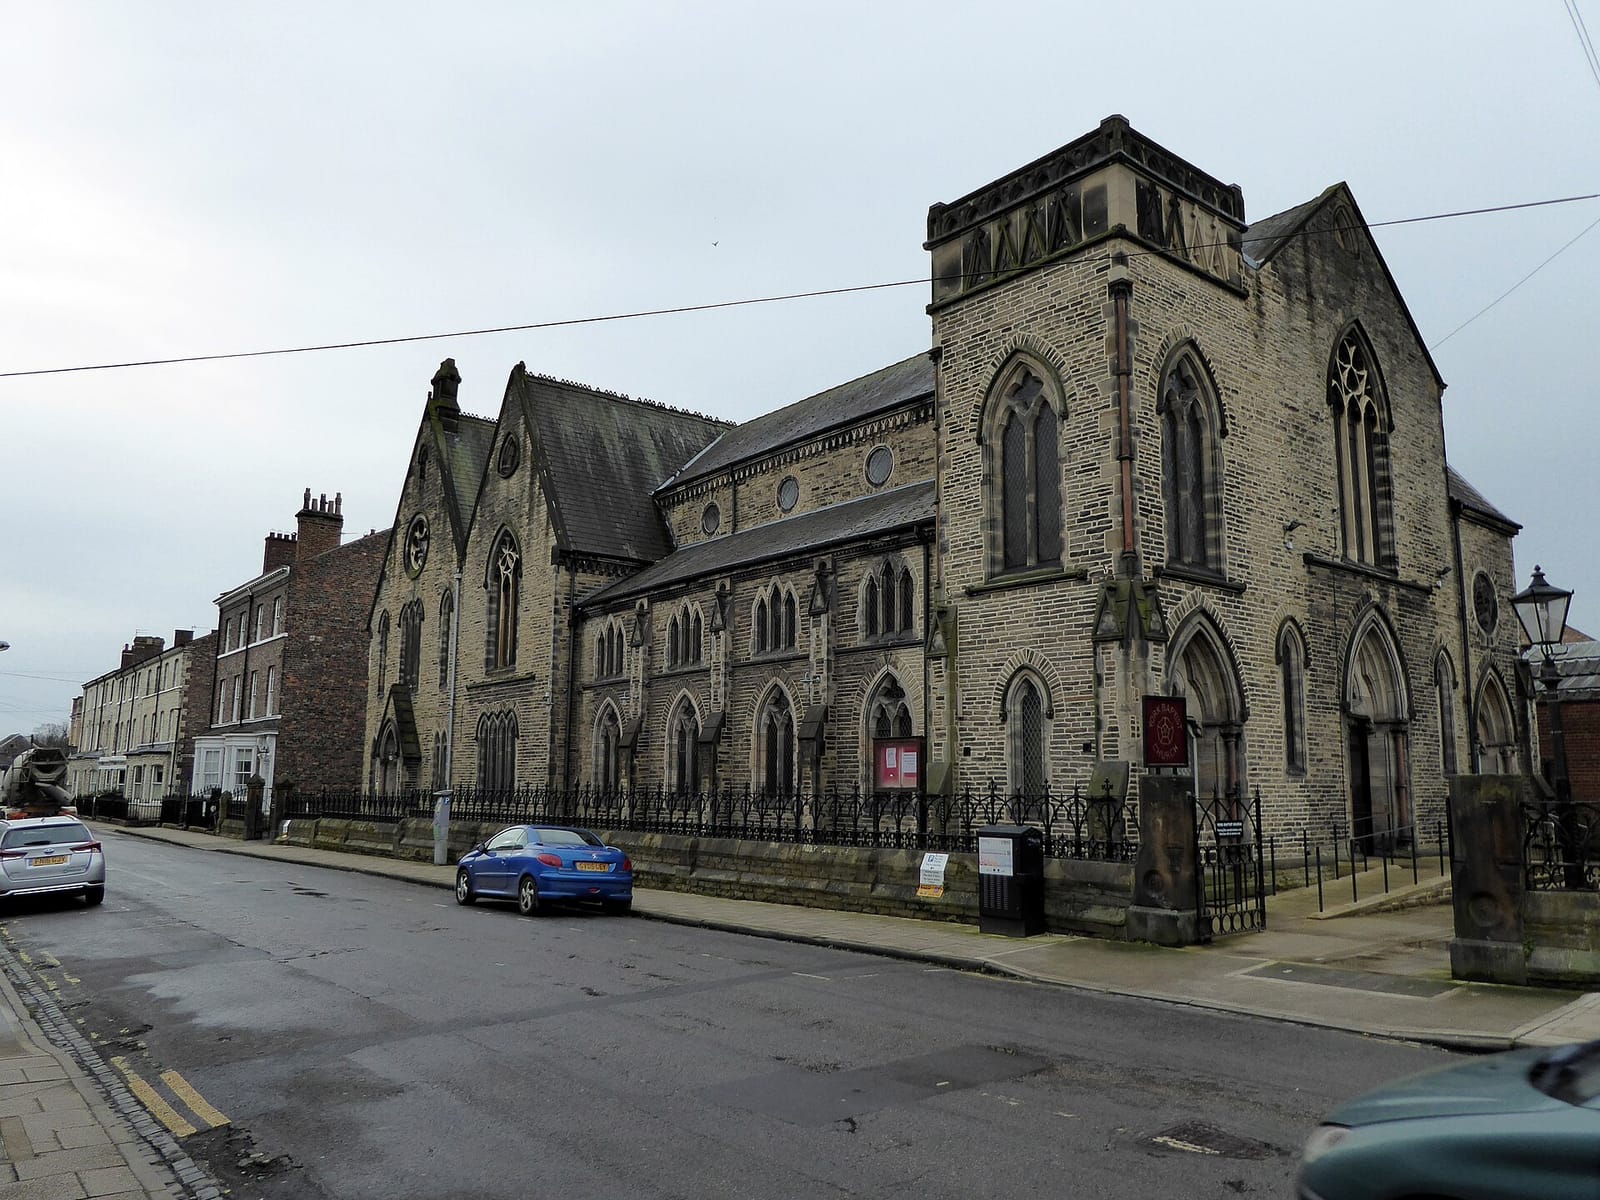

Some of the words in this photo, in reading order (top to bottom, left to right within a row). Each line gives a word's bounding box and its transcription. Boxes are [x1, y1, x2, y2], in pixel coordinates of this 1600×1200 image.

[1149, 705, 1161, 727] YORK
[1161, 703, 1183, 729] BAPTIST
[1153, 743, 1179, 760] CHURCH
